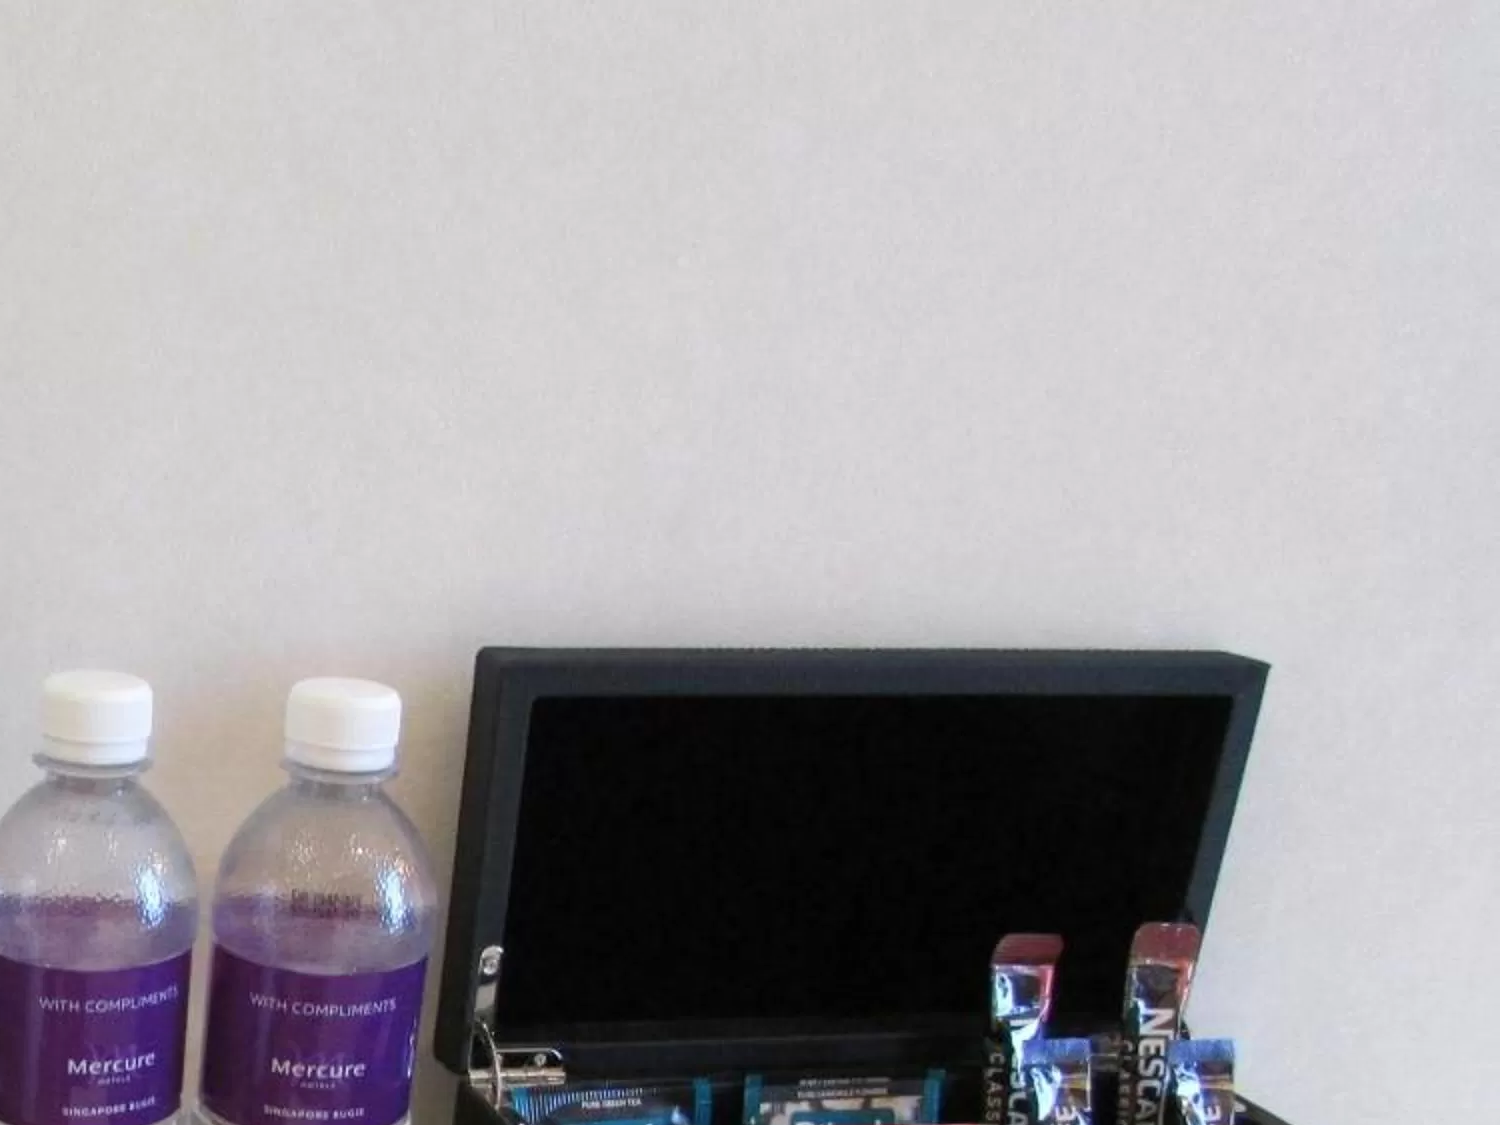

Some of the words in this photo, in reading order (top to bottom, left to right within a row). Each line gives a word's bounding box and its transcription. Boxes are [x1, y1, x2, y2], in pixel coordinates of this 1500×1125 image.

[38, 995, 80, 1013] WITH
[85, 983, 179, 1014] COMPLIMENTS
[249, 991, 287, 1013] WITH
[291, 996, 397, 1018] COMPLIMENTS
[67, 1052, 156, 1075] Mercure
[271, 1057, 367, 1079] Mercure
[61, 1103, 127, 1118] SINGAPORE
[263, 1104, 329, 1120] SINGAPORE
[627, 1097, 642, 1107] TEA
